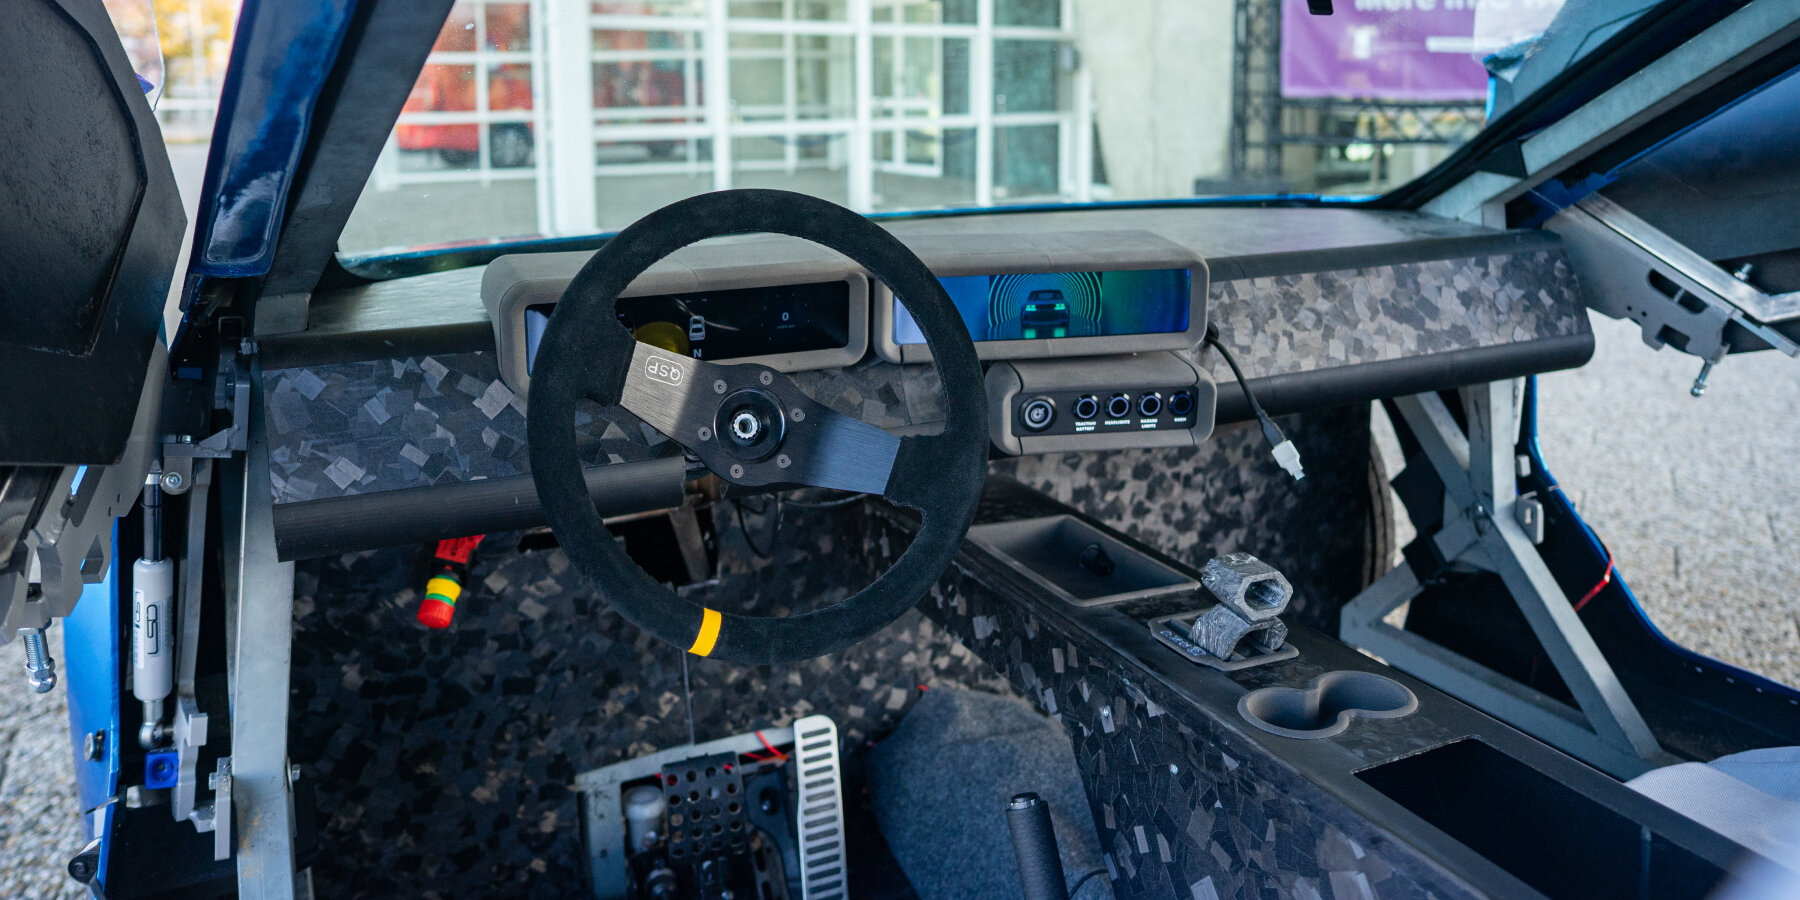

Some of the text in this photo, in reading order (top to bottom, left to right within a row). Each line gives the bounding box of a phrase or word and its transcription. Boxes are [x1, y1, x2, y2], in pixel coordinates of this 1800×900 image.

[781, 312, 789, 321] 0
[693, 348, 702, 358] N
[648, 362, 680, 381] QSP
